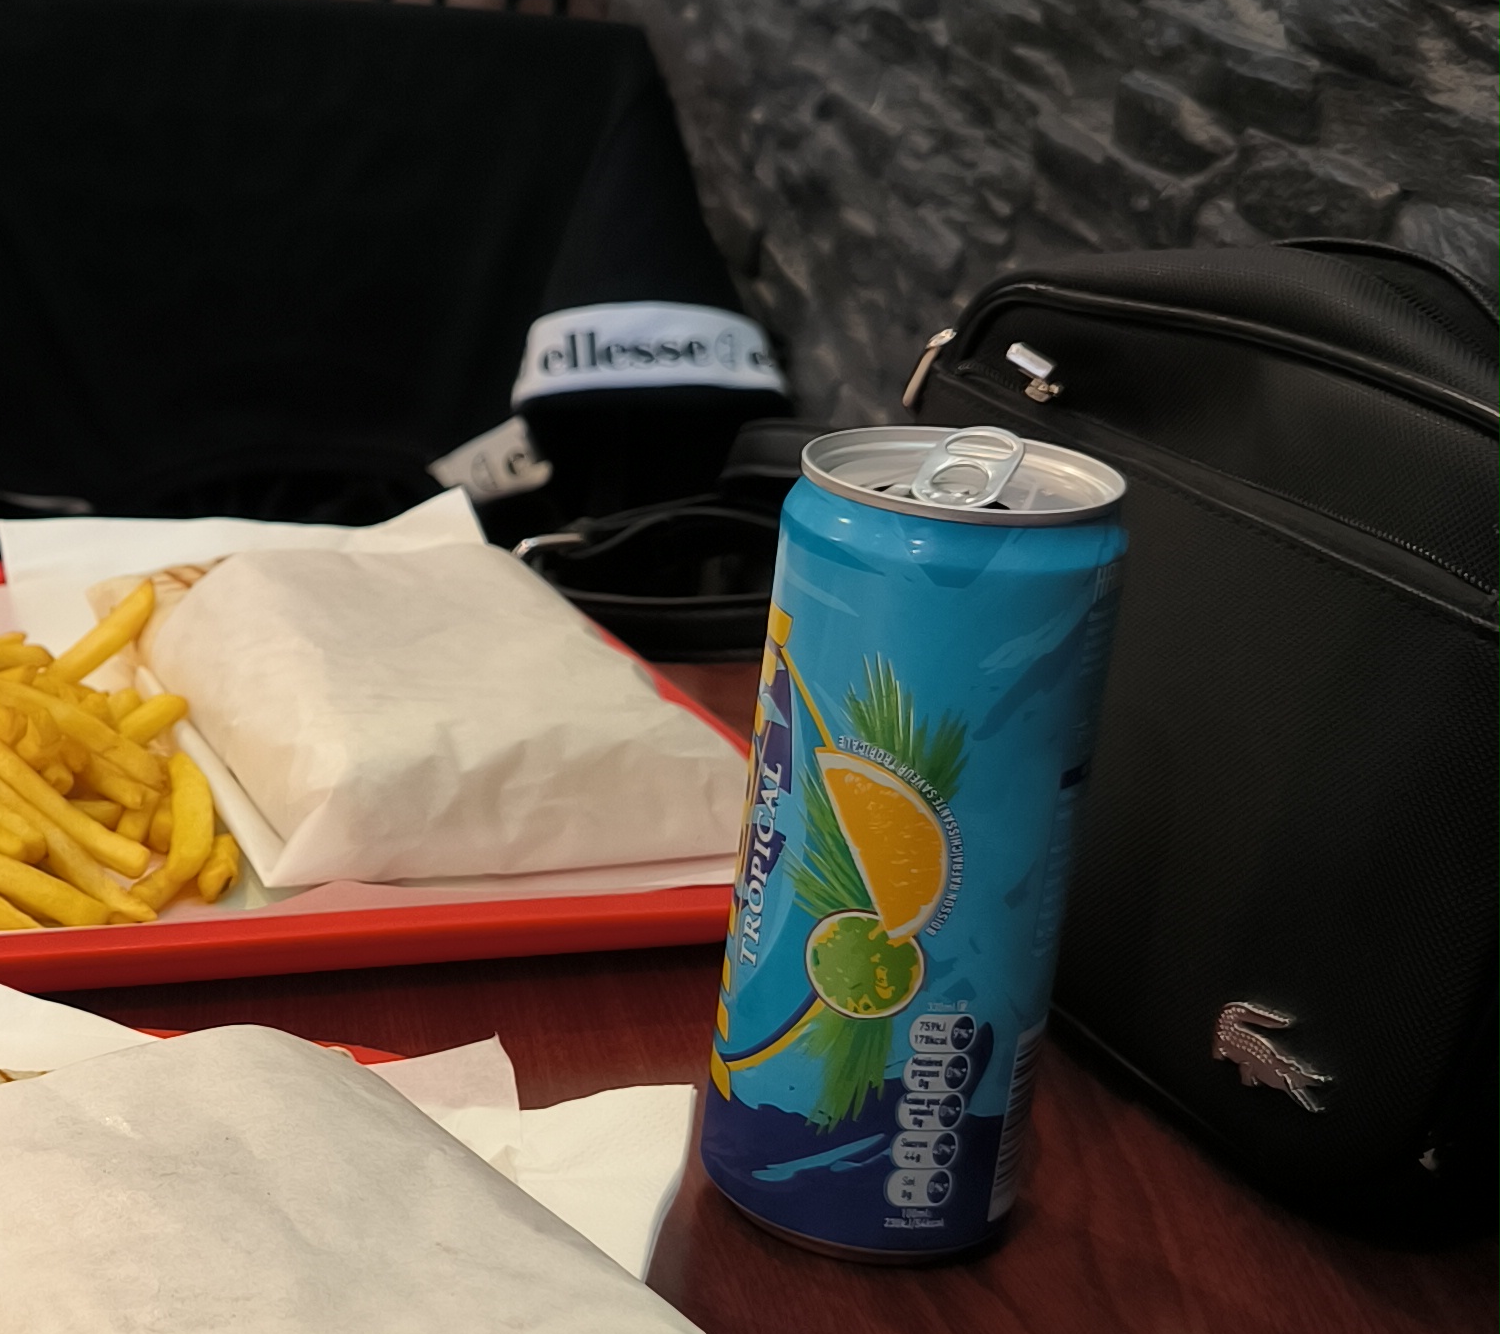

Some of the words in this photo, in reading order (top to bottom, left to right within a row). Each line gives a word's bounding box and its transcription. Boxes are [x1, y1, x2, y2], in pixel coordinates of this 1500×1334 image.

[542, 331, 707, 372] ellesse
[837, 734, 898, 771] TROPICALE
[897, 762, 938, 799] SAVEUR
[739, 760, 782, 967] TROPICAL
[925, 892, 957, 937] BOISSON
